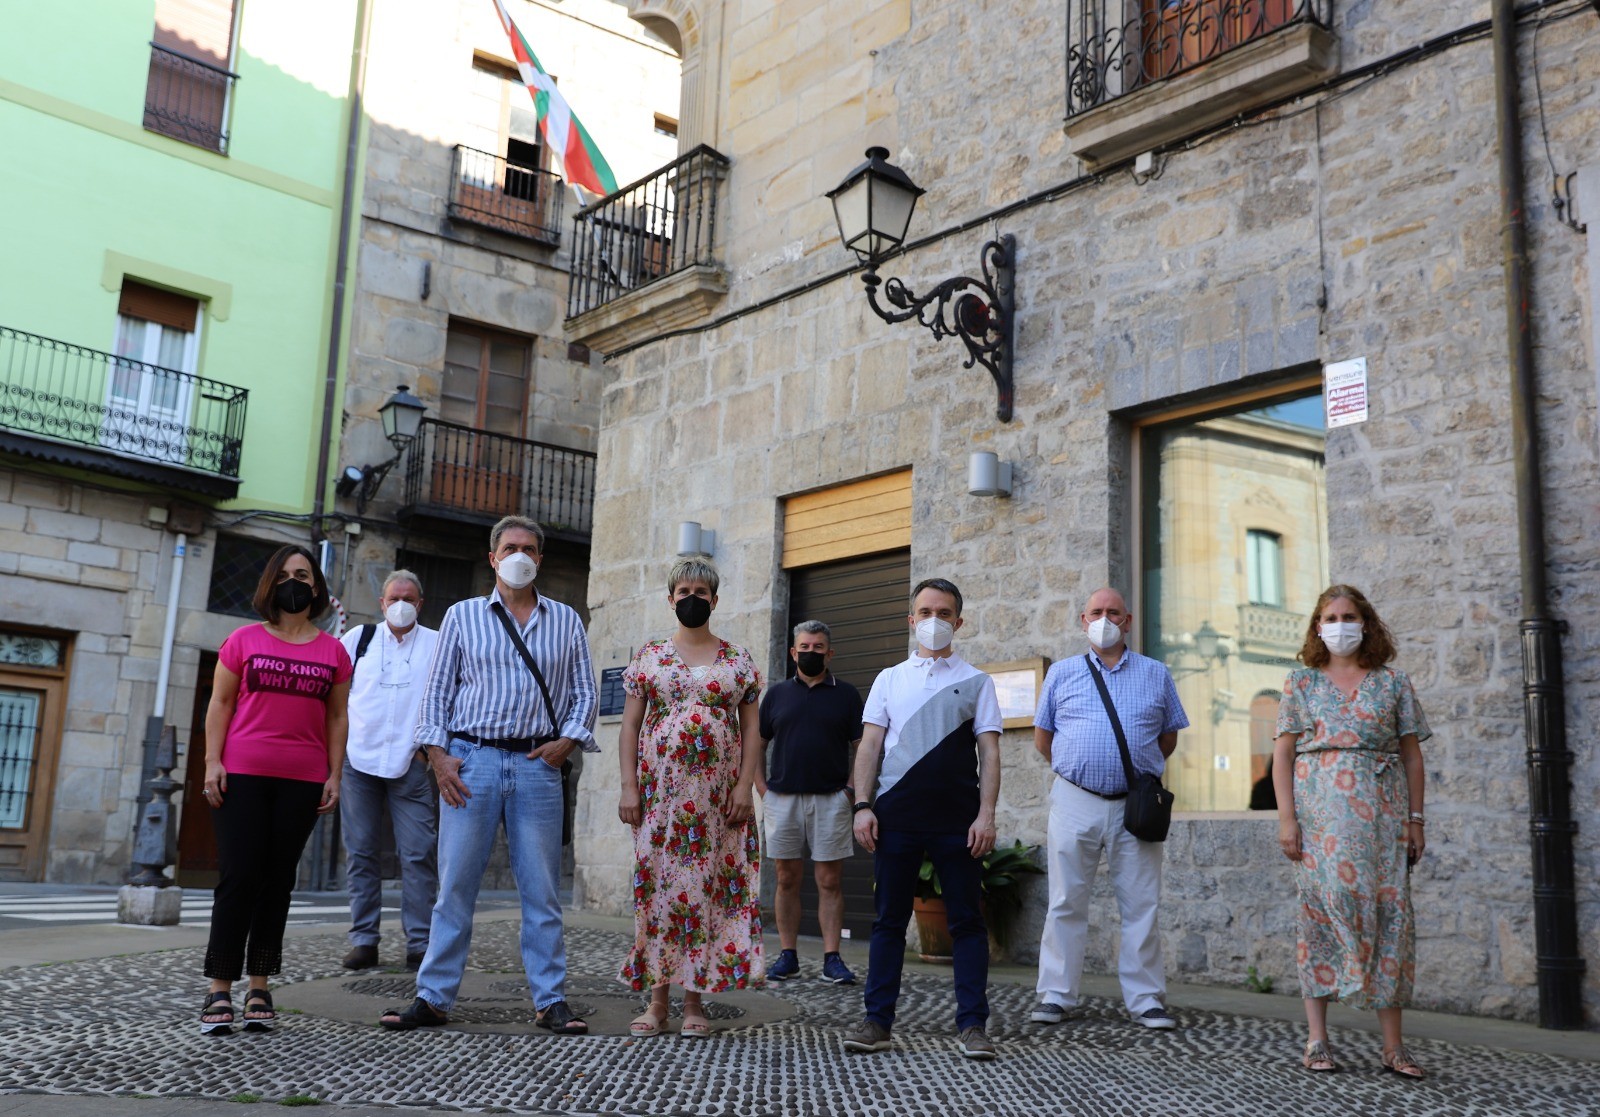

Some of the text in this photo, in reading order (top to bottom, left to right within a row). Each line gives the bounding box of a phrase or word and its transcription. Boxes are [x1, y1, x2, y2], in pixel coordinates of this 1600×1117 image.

[1330, 386, 1364, 400] Alarma
[252, 657, 286, 672] WHO
[259, 672, 293, 689] WHY
